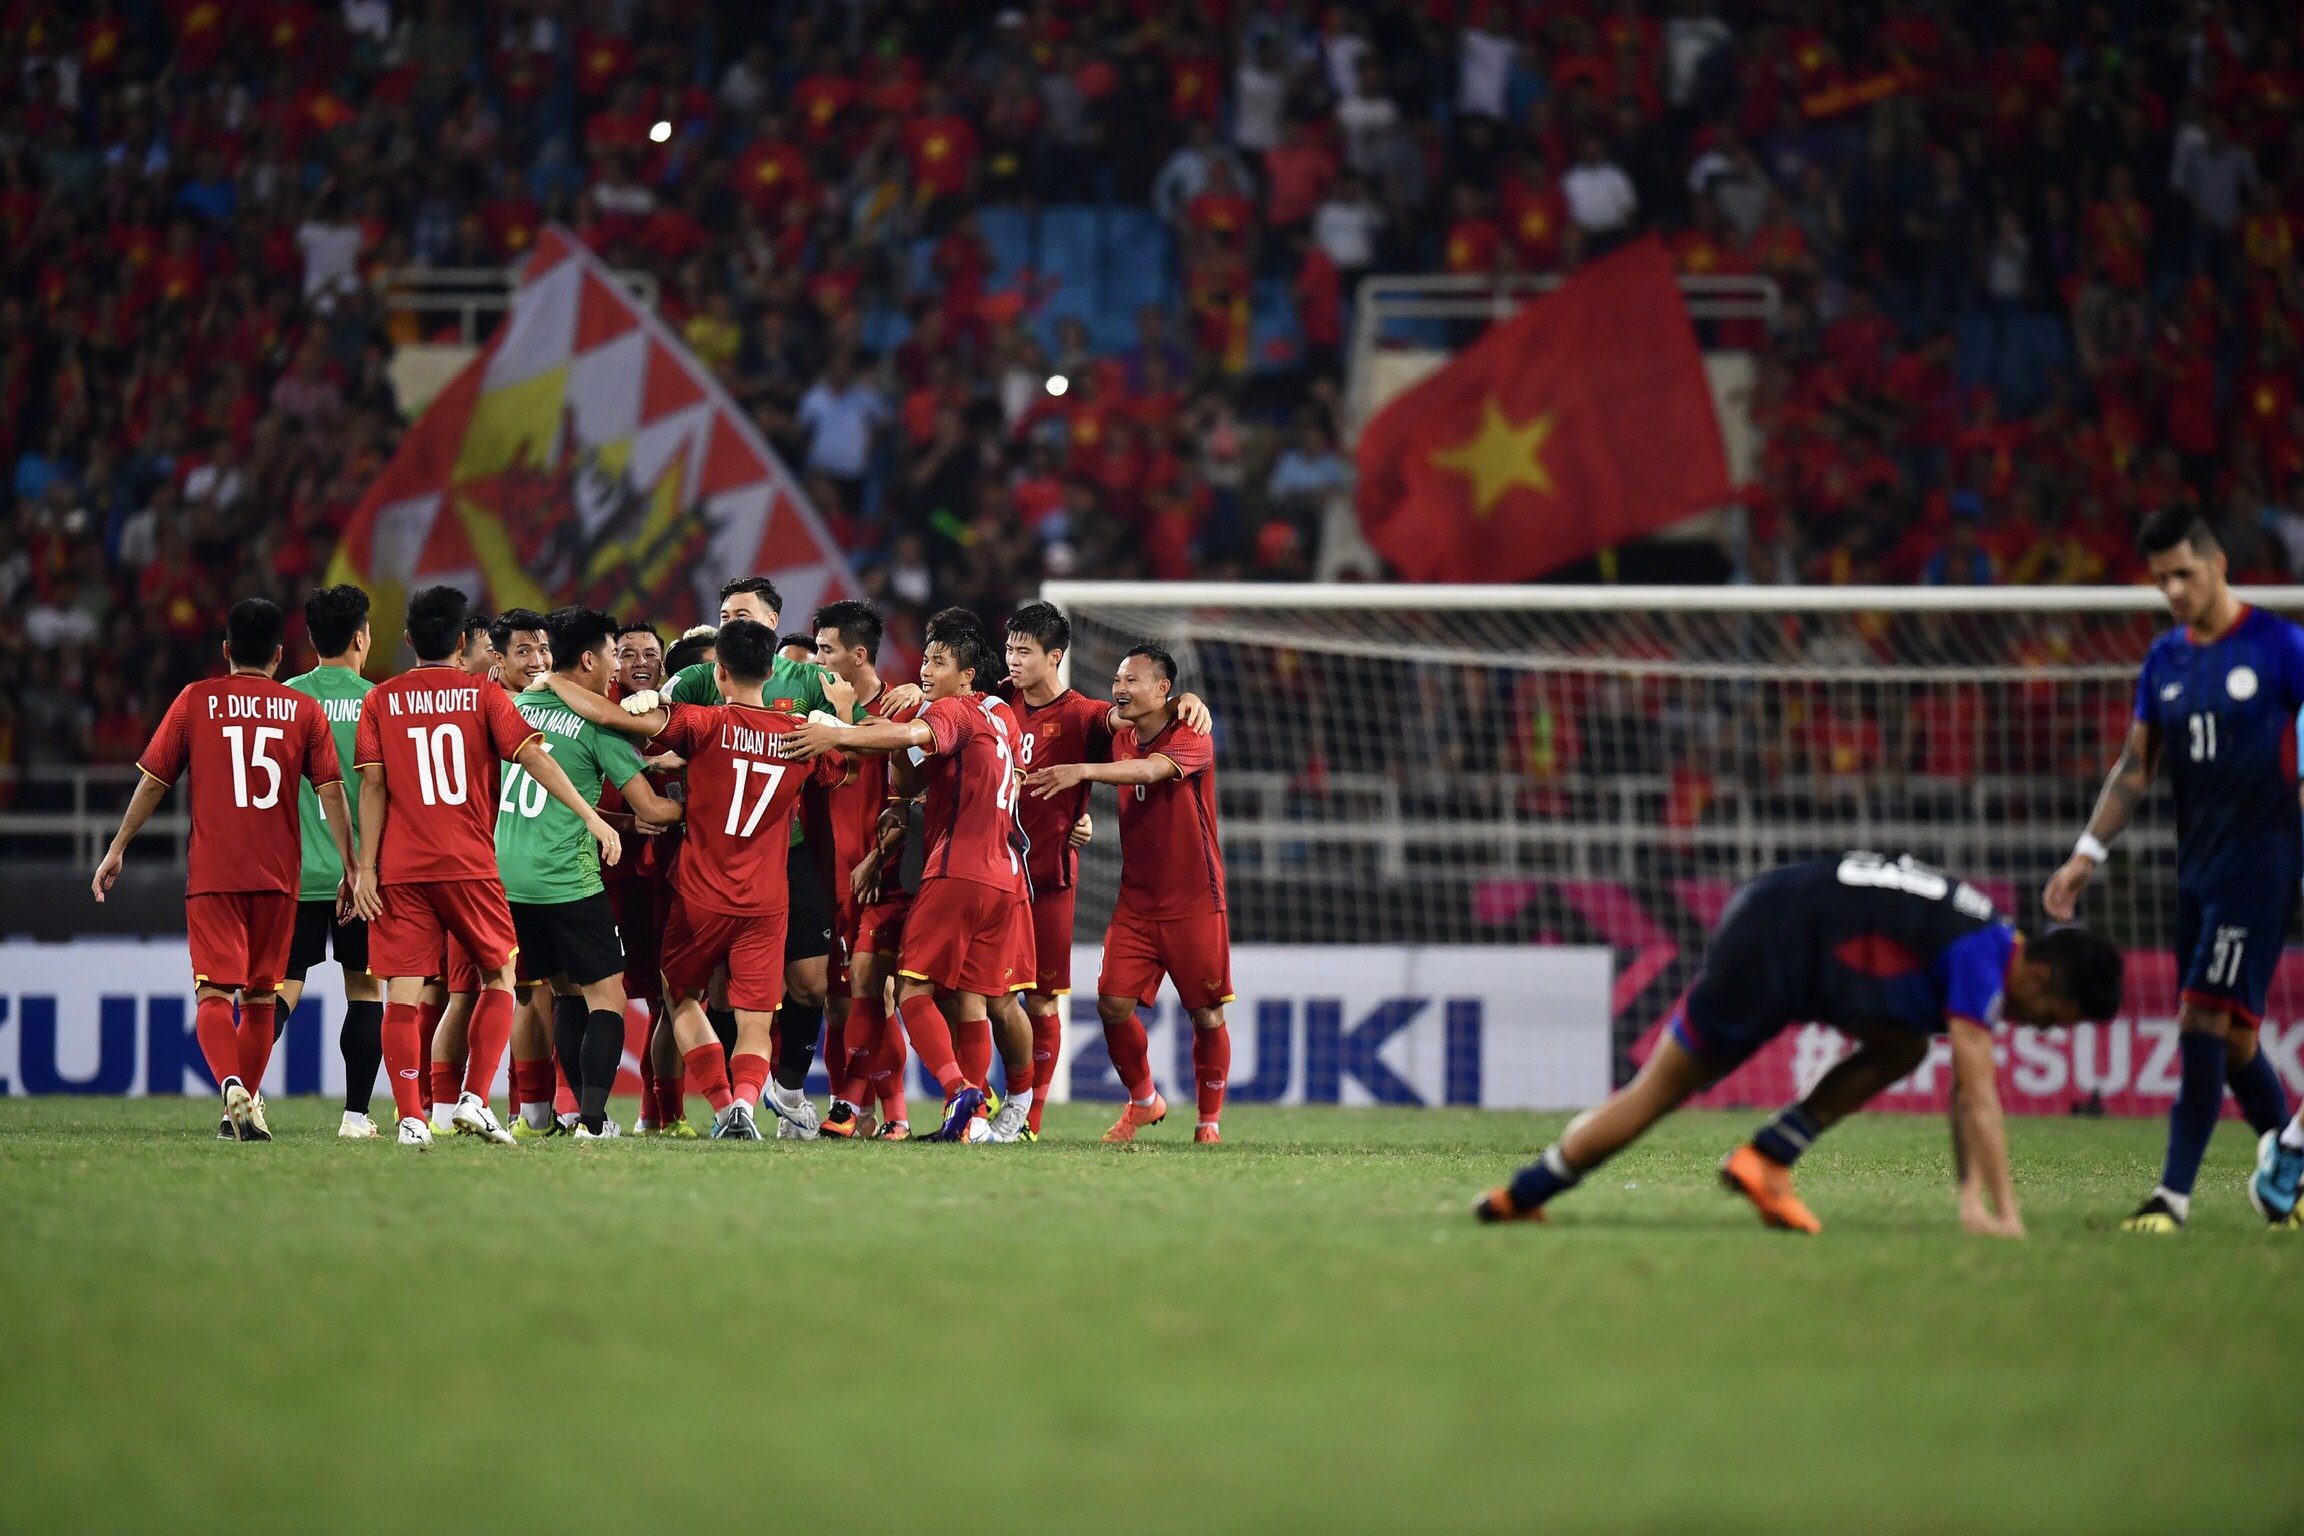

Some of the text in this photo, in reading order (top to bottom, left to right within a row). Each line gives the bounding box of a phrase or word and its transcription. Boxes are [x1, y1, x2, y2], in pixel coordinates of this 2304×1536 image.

[208, 694, 298, 722] P. DUC HUY
[388, 688, 479, 716] N. VAN QUYET
[543, 709, 586, 740] MANH
[721, 723, 730, 749] L.
[732, 725, 765, 756] XUAN
[222, 725, 284, 809] 15
[407, 723, 467, 806] 10
[724, 757, 787, 837] 17
